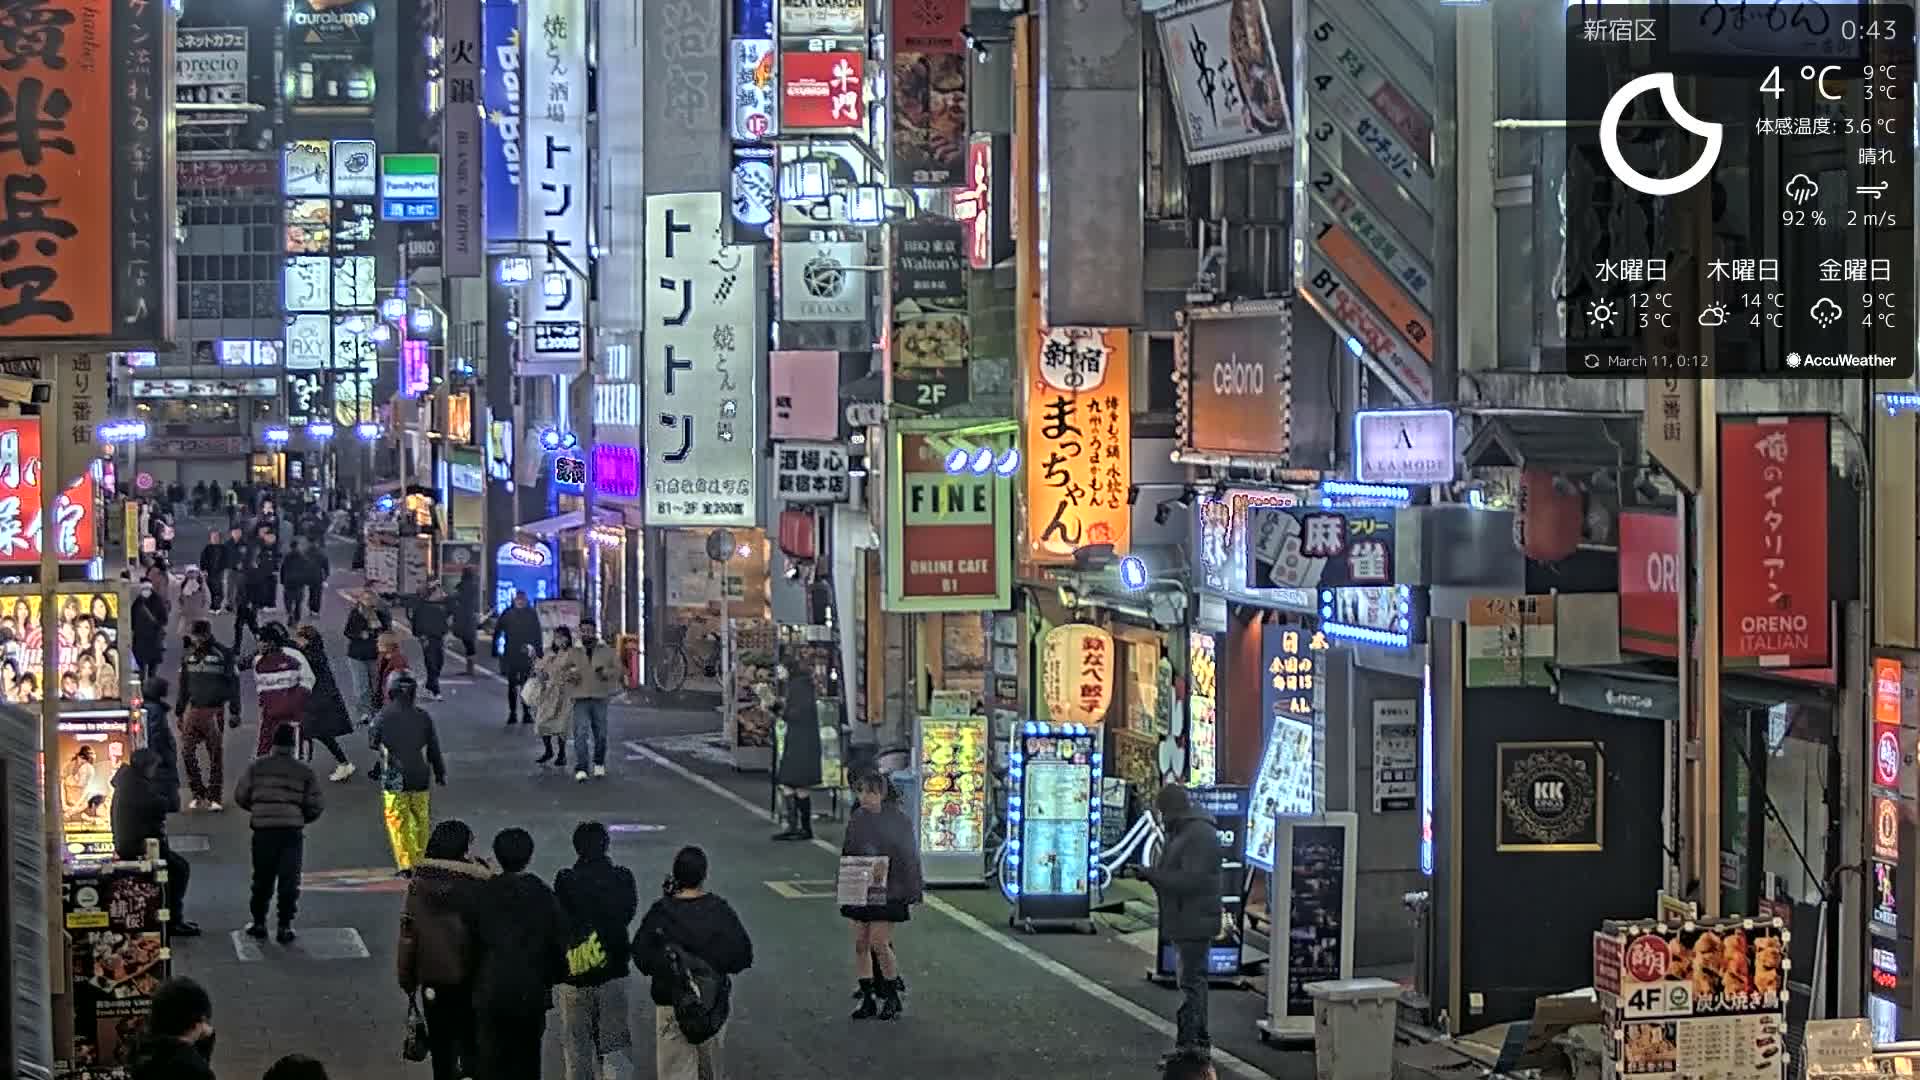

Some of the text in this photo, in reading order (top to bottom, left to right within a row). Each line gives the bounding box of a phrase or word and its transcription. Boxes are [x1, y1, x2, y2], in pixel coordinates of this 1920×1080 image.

[1313, 21, 1336, 42] 5
[829, 58, 860, 120] 牛門
[1314, 75, 1333, 91] 4
[1314, 122, 1335, 142] 3
[386, 180, 436, 192] FamilyMart
[1312, 171, 1334, 193] 2
[1315, 221, 1333, 239] 1
[901, 256, 960, 271] Walton's
[1311, 267, 1341, 298] B1
[659, 209, 694, 463] トントン
[1213, 352, 1264, 395] celona
[917, 384, 947, 405] 2F
[1040, 396, 1087, 546] まっちゃん
[911, 484, 986, 513] FINE
[1349, 520, 1390, 535] フリー
[1754, 431, 1789, 604] 俺のイタリアン
[911, 559, 988, 575] ONLINE CAFE
[942, 579, 958, 593] B1
[1741, 615, 1808, 633] ORENO
[1739, 632, 1809, 652] ITALIAN
[1533, 781, 1565, 799] KK
[1627, 988, 1662, 1011] 4F
[1695, 991, 1779, 1013] 炭火焼き鳥
